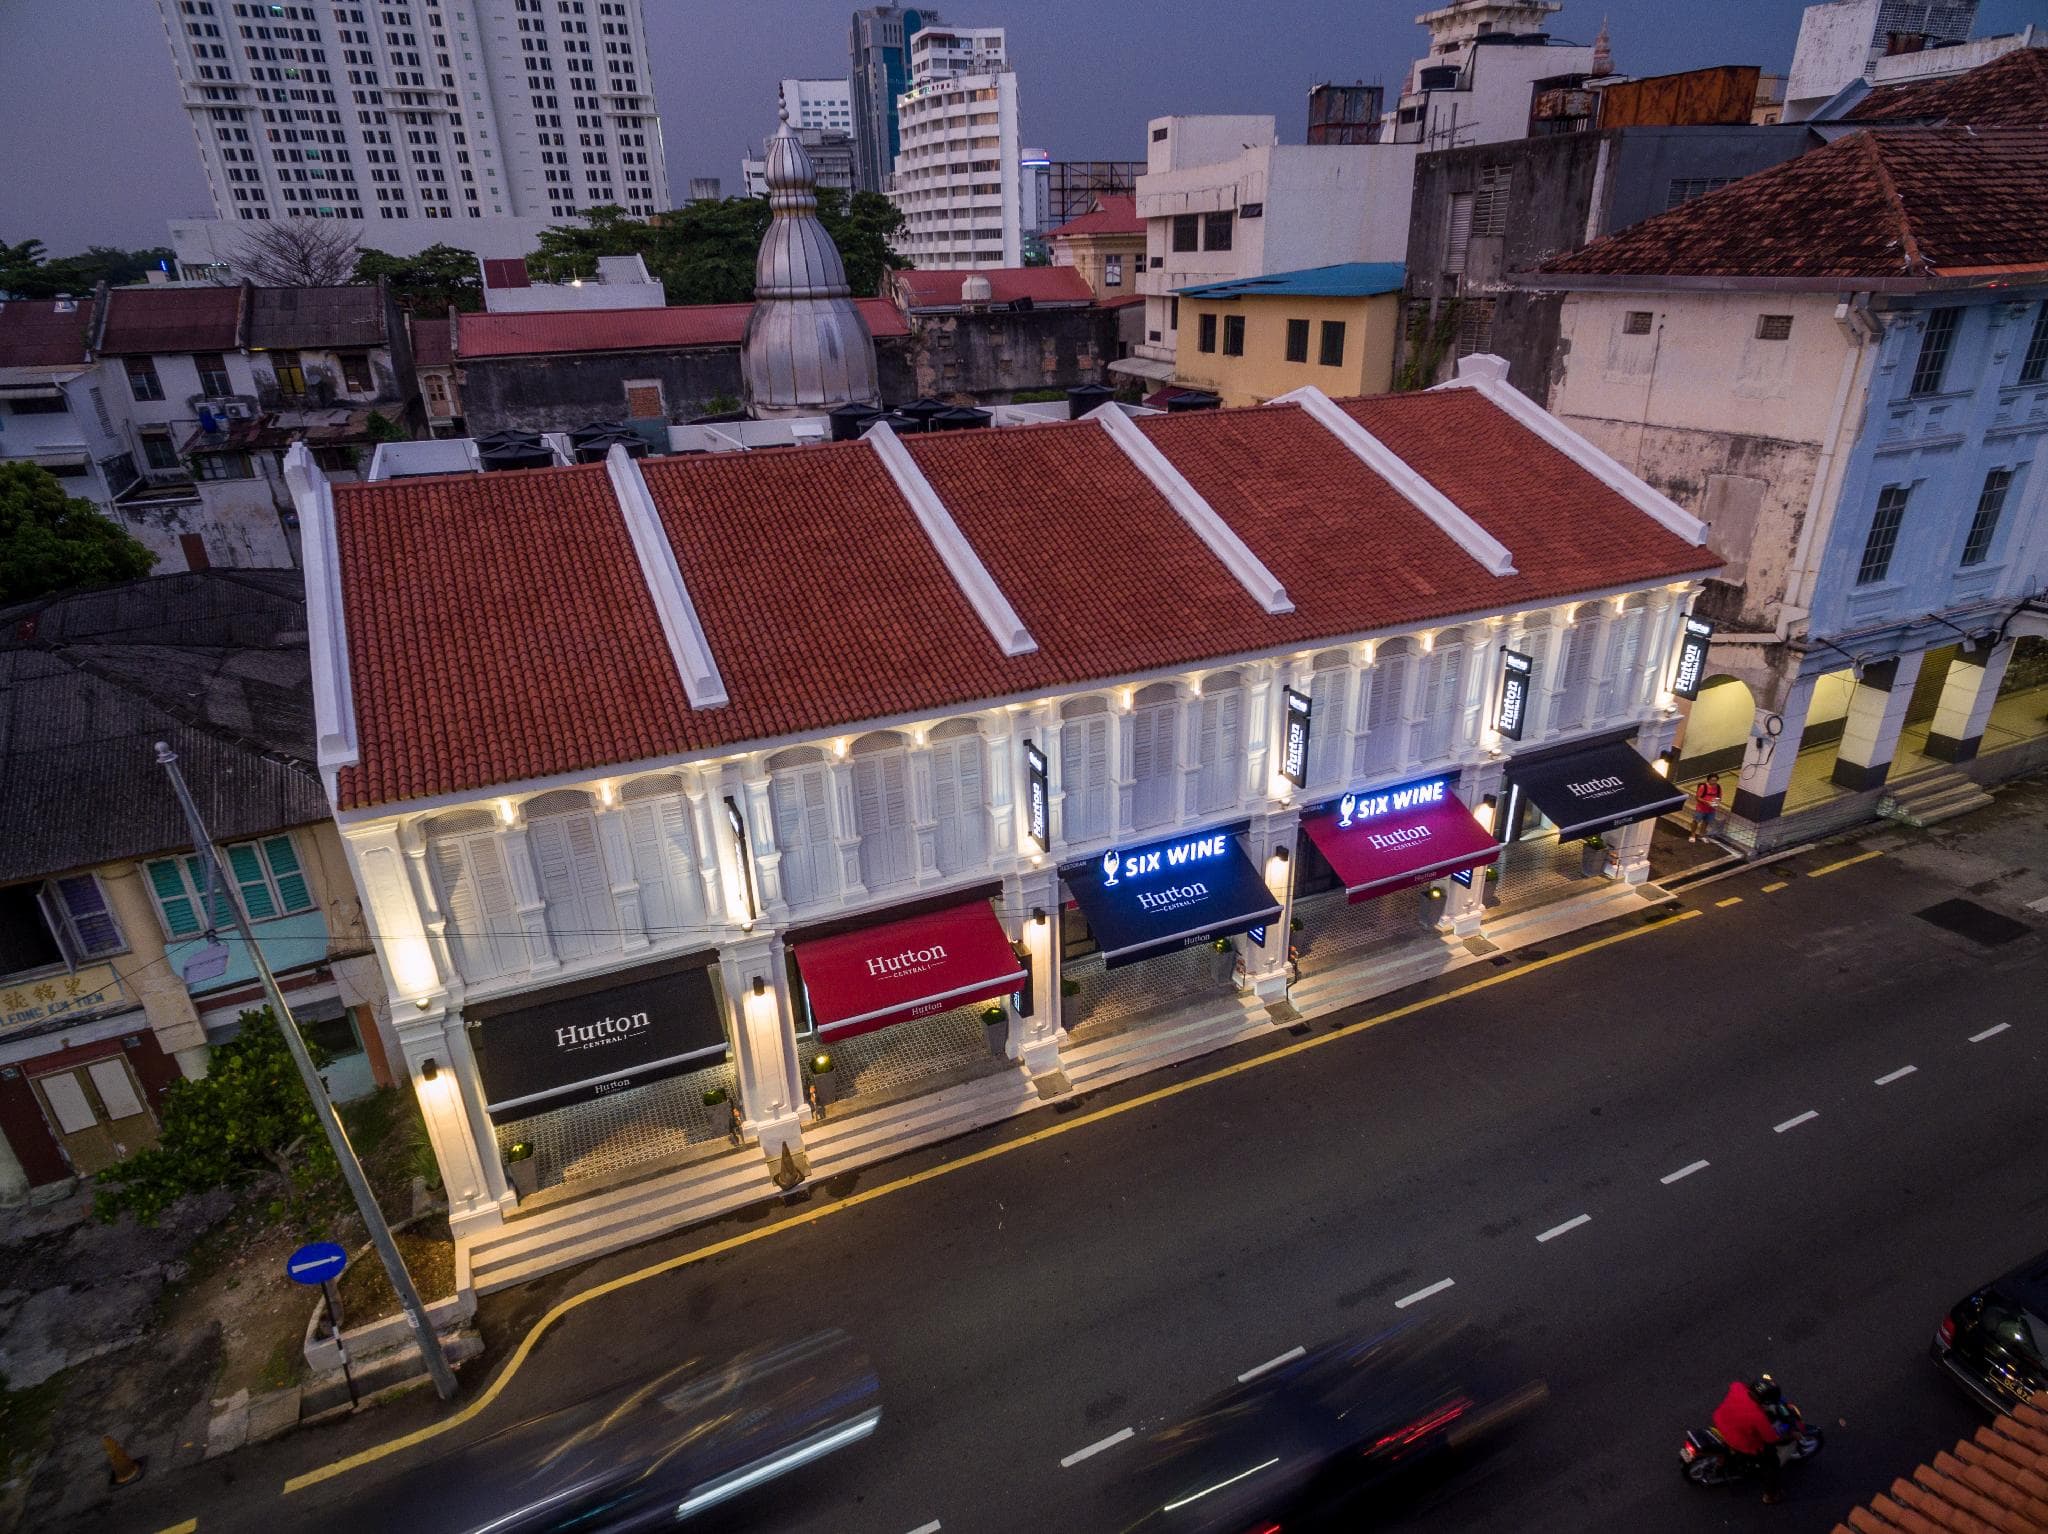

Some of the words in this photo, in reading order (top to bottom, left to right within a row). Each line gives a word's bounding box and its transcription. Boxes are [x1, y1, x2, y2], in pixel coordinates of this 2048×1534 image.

[1675, 644, 1698, 691] Hutton
[1500, 680, 1519, 730] Hutton
[1287, 723, 1300, 776] Hutton
[1356, 795, 1389, 819] SIX
[1392, 781, 1445, 810] WINE
[1567, 776, 1624, 797] Hutton
[1367, 824, 1432, 850] Hutton
[1125, 851, 1161, 877] SIX
[1166, 835, 1227, 866] WINE
[1136, 882, 1209, 910] Hutton
[1184, 934, 1210, 946] Hutton
[865, 945, 948, 977] Hutton
[893, 965, 927, 979] CENTRAL
[911, 1001, 943, 1016] Hutton
[554, 1011, 651, 1047] Hutton
[583, 1035, 622, 1051] CENTRAL
[595, 1078, 631, 1095] Hutton
